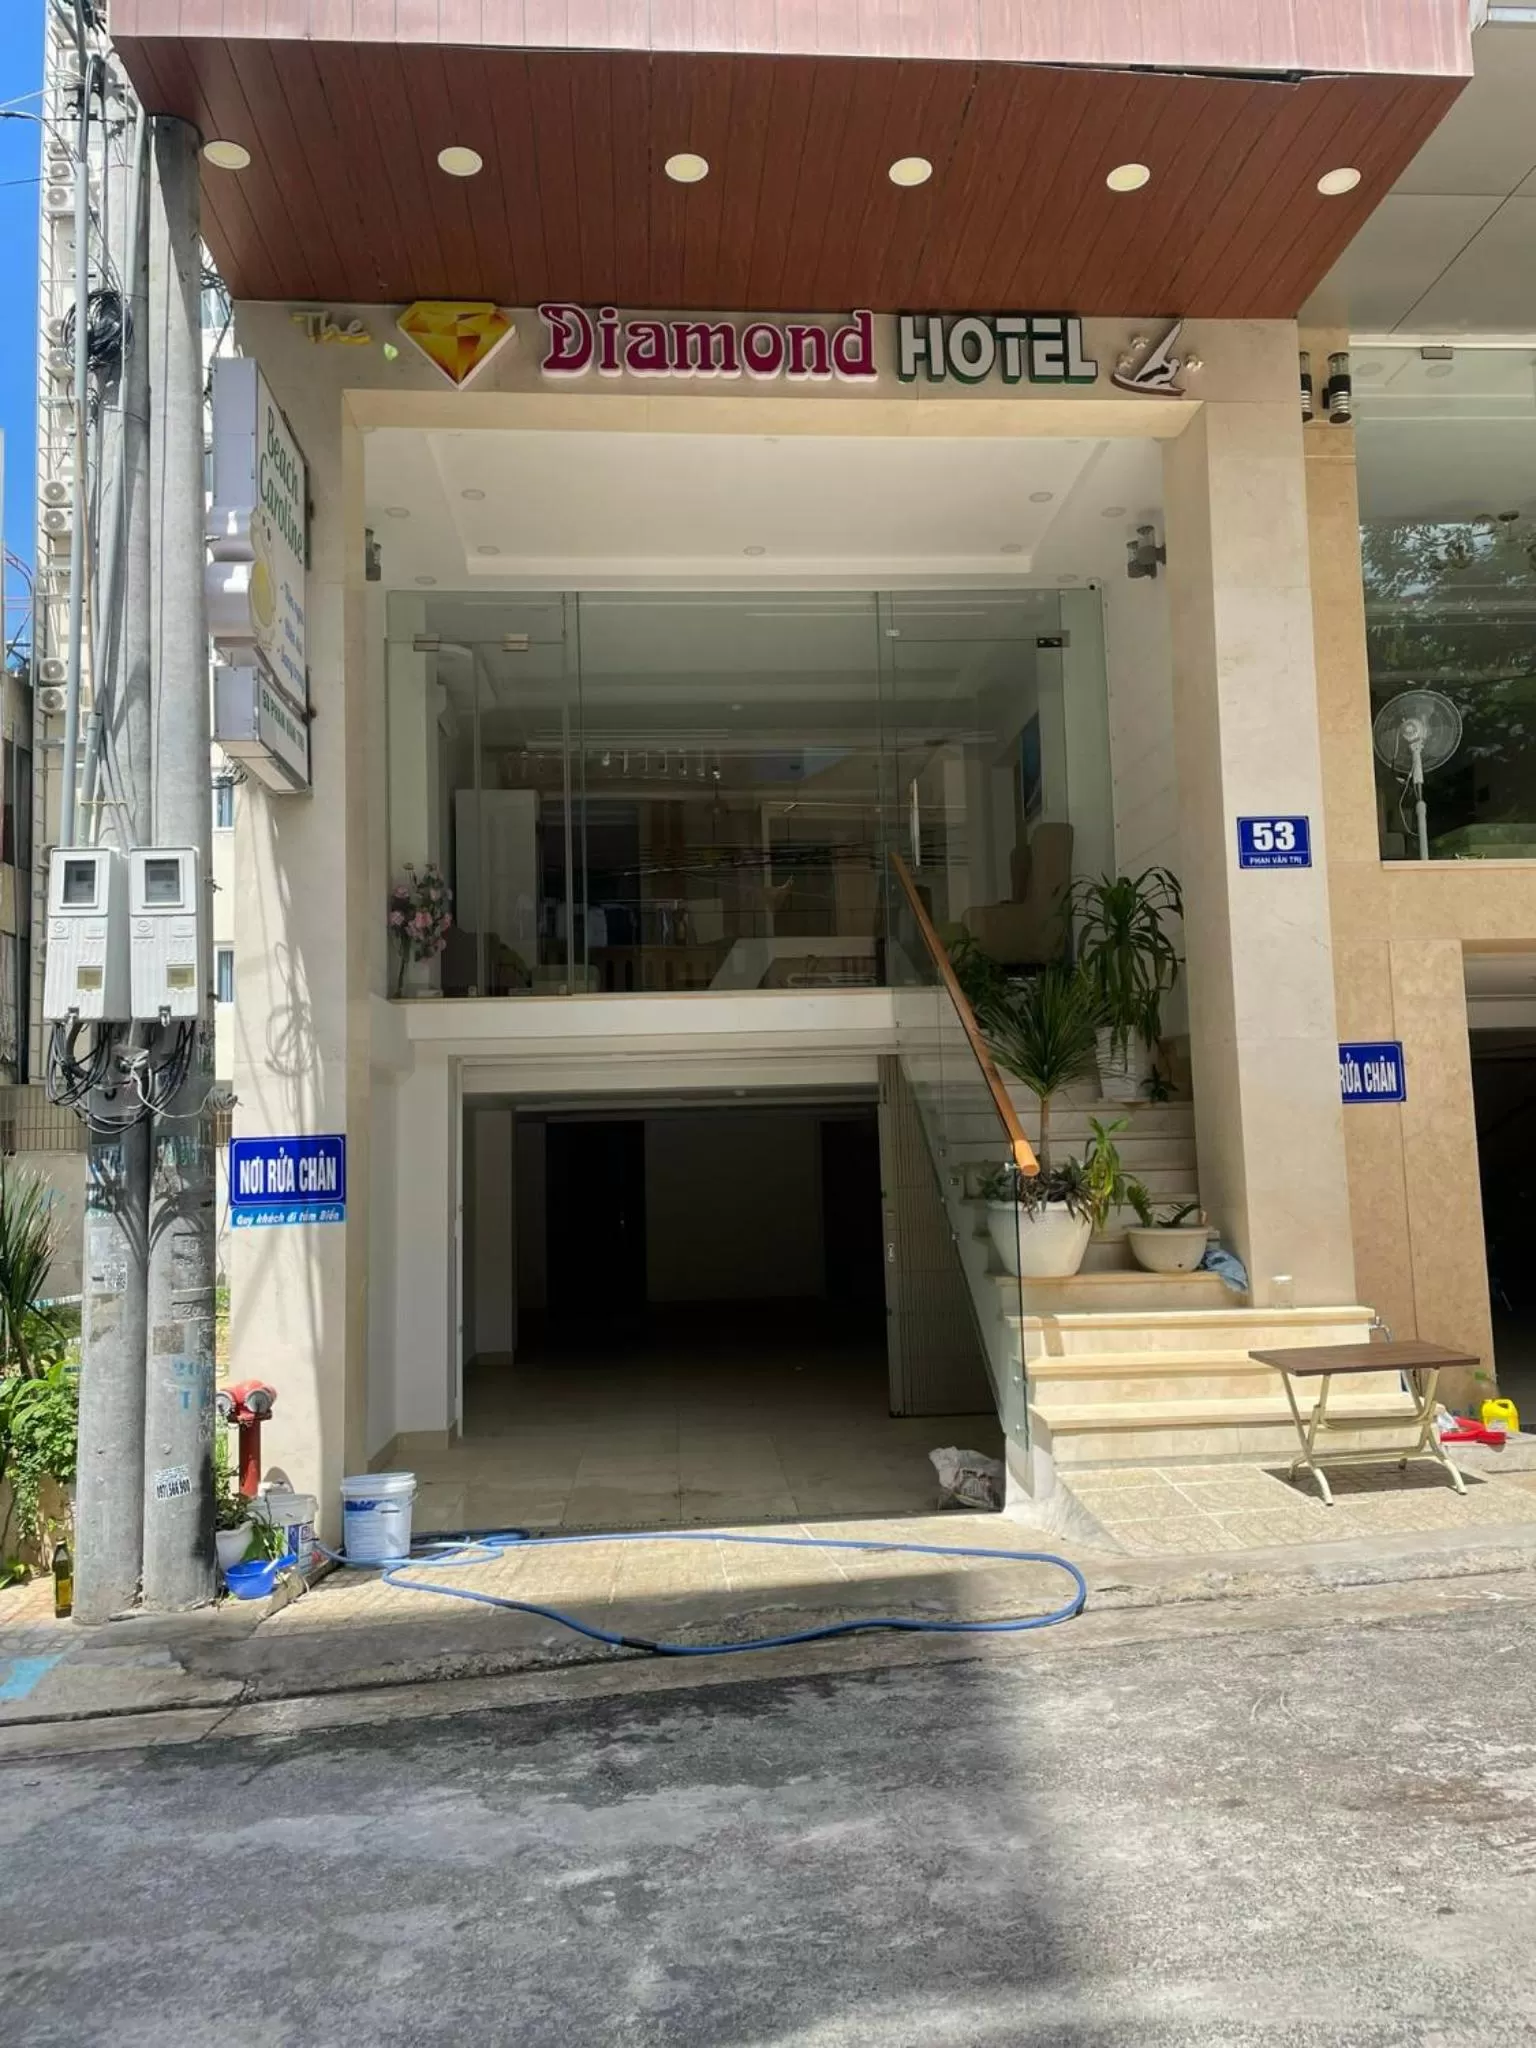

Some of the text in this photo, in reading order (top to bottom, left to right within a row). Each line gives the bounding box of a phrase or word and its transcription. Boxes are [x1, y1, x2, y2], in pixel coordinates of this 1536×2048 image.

[292, 303, 1098, 384] The Diamond HOTEL
[267, 406, 298, 505] Beach
[260, 452, 303, 564] Caroline
[1252, 821, 1295, 851] 53
[1250, 856, 1270, 865] PHAN
[1363, 1055, 1398, 1093] CHÂN
[240, 1147, 337, 1195] NƠI RỬA CHÂN
